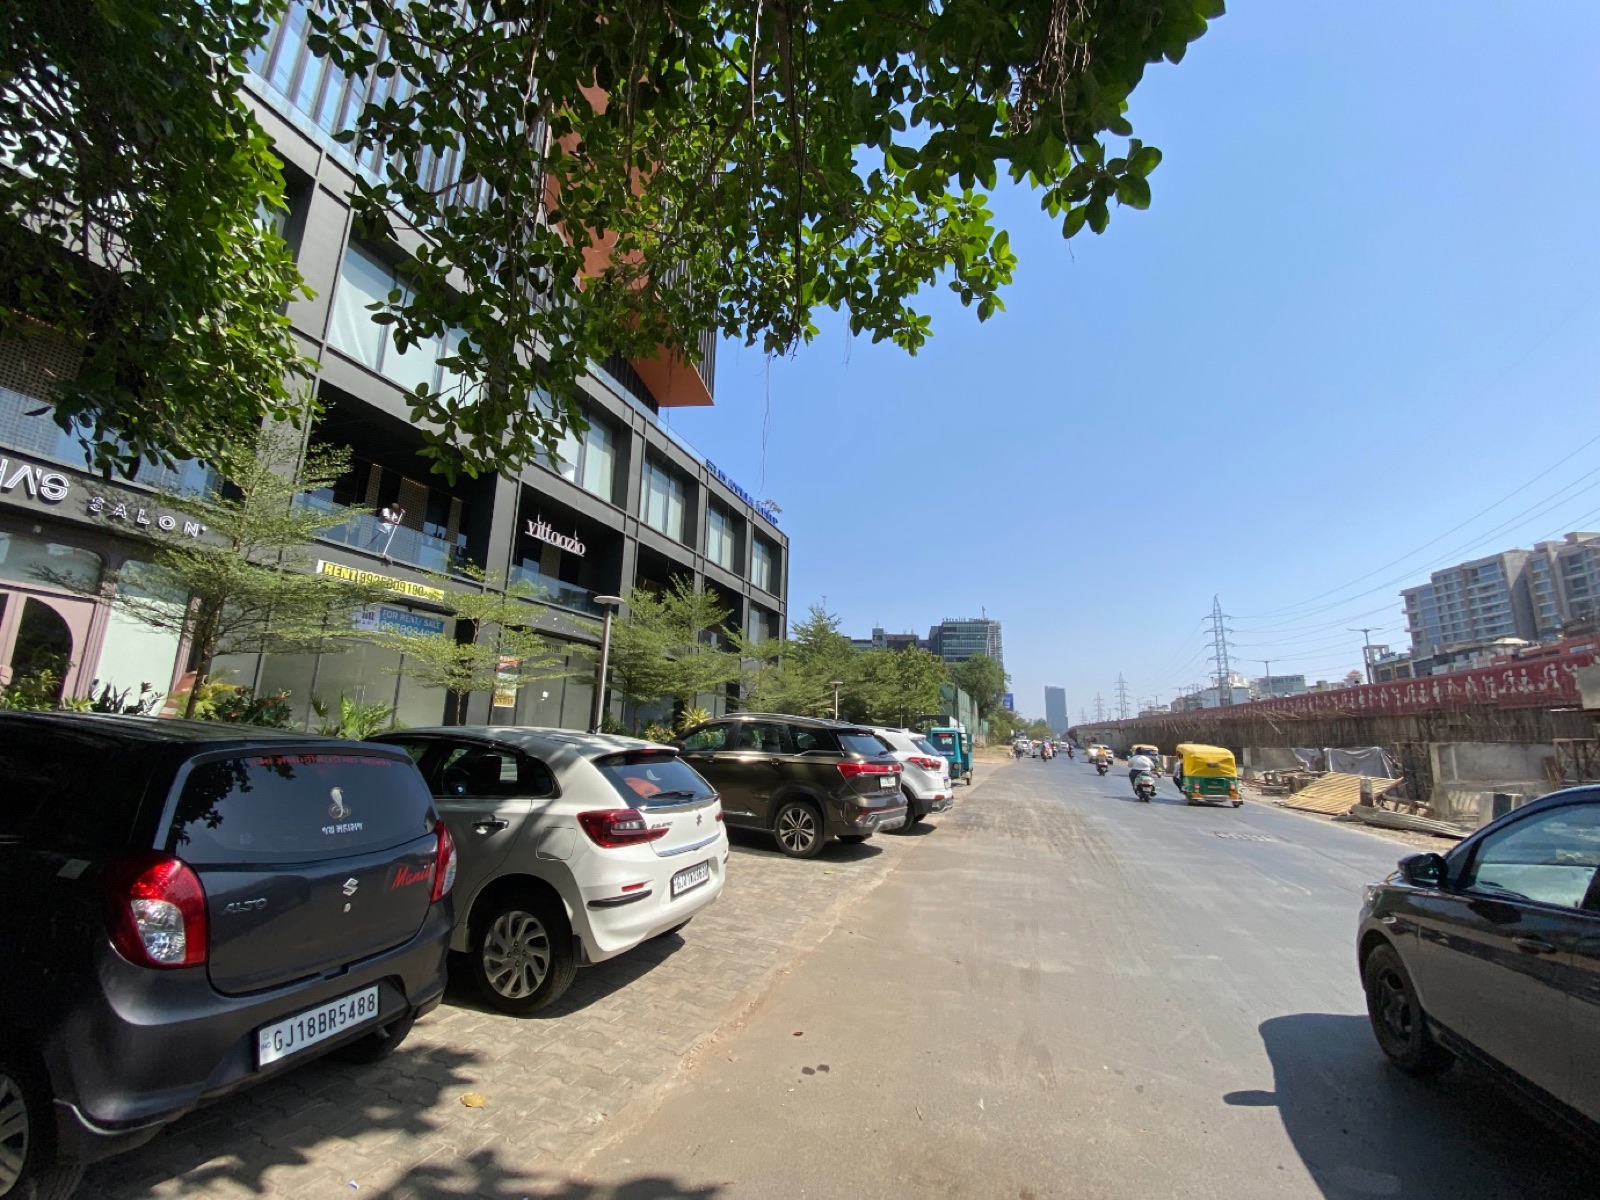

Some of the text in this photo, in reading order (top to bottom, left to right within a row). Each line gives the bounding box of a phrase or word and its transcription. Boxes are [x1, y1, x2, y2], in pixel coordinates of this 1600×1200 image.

[89, 496, 199, 537] SALON
[324, 562, 357, 583] RENT
[382, 609, 398, 620] FOR
[423, 619, 441, 630] SALE
[221, 897, 268, 915] ALTO
[273, 993, 375, 1052] GJ18BR5488
